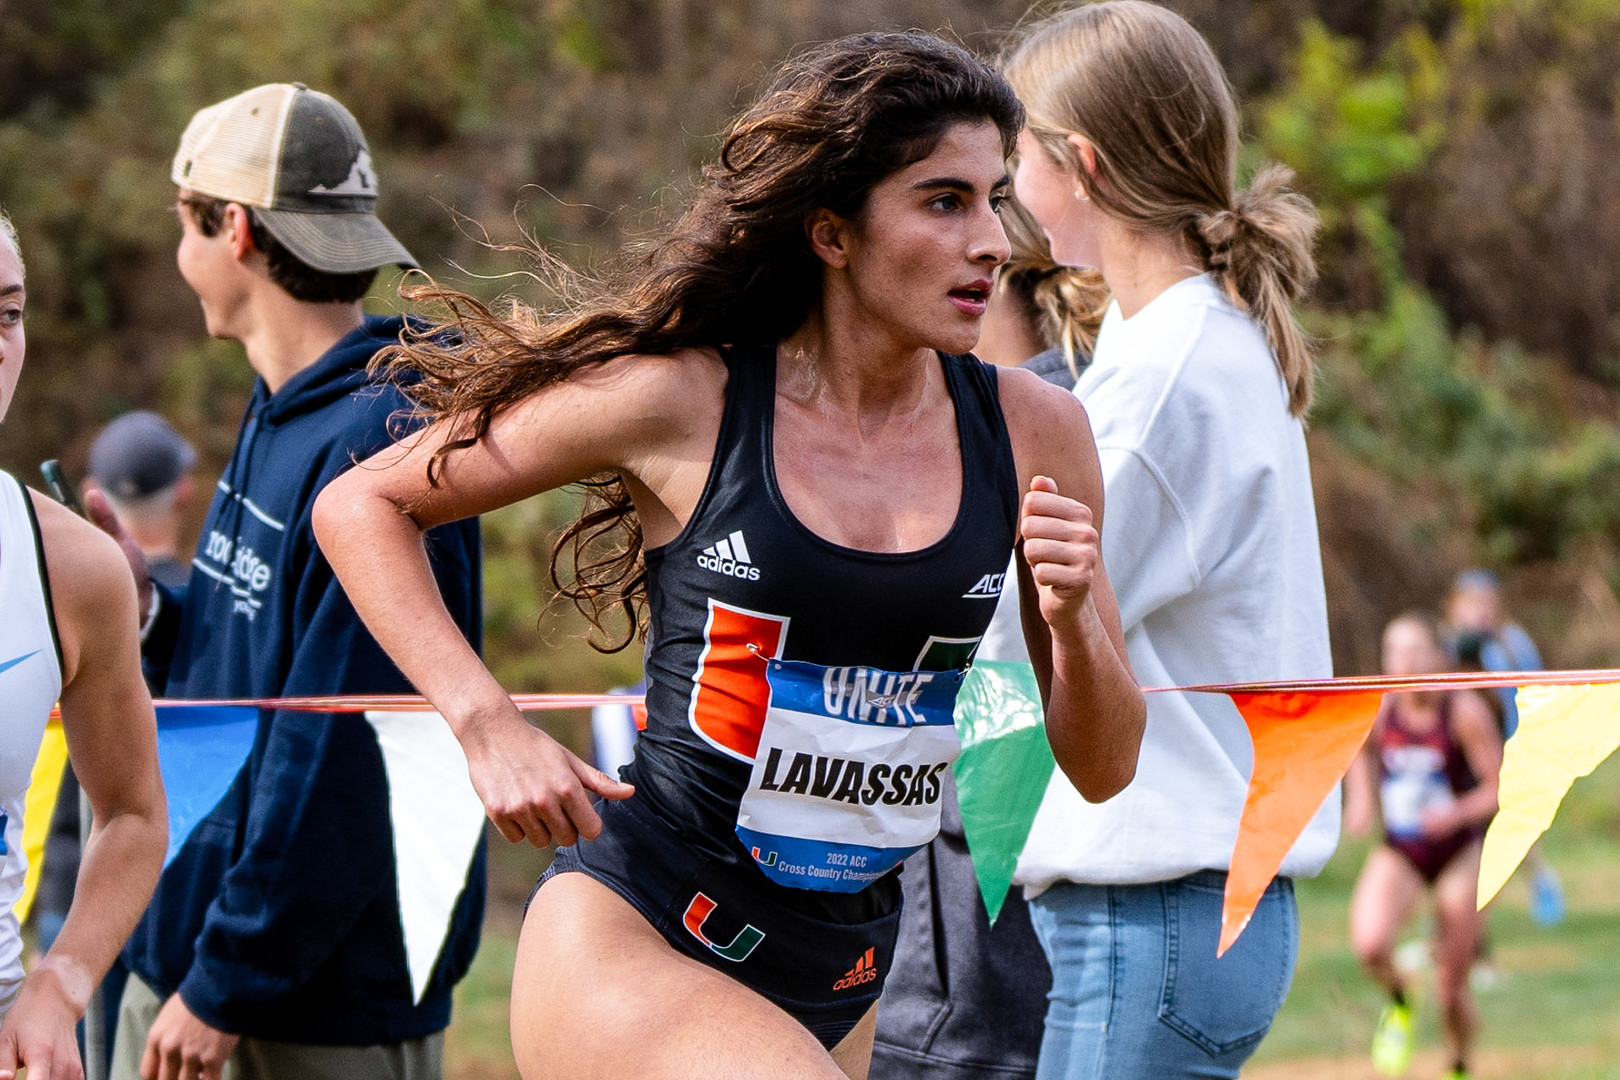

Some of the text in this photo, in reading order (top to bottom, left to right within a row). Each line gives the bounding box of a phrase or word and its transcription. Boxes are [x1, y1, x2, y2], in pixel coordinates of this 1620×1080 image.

[697, 553, 761, 581] adidas
[759, 746, 949, 807] LAVASSAS
[778, 860, 806, 875] Cross
[807, 865, 842, 881] Country
[826, 852, 868, 868] 2022 ACC
[833, 967, 877, 991] adidas
